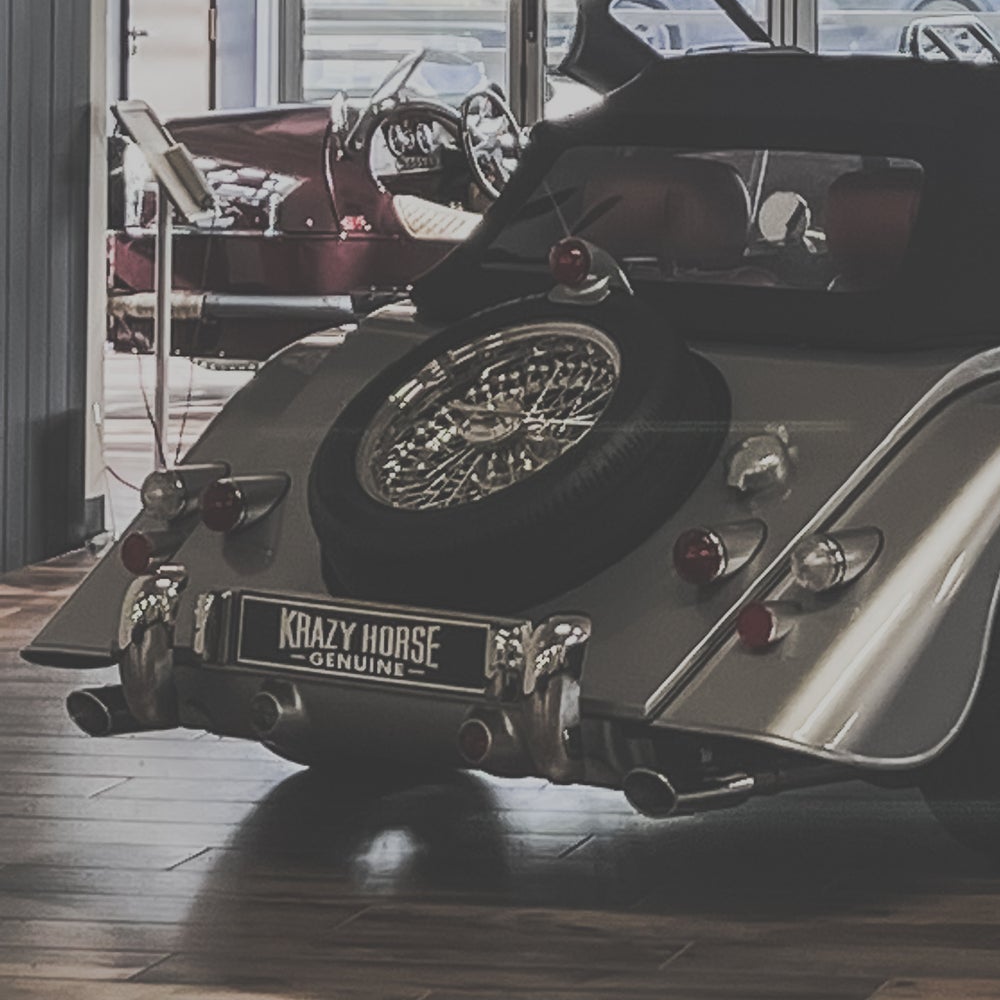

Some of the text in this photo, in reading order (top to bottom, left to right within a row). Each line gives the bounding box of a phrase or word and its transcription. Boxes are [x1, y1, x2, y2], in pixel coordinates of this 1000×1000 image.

[279, 607, 441, 669] KRAZY HORSE
[309, 651, 404, 677] GENUINE
